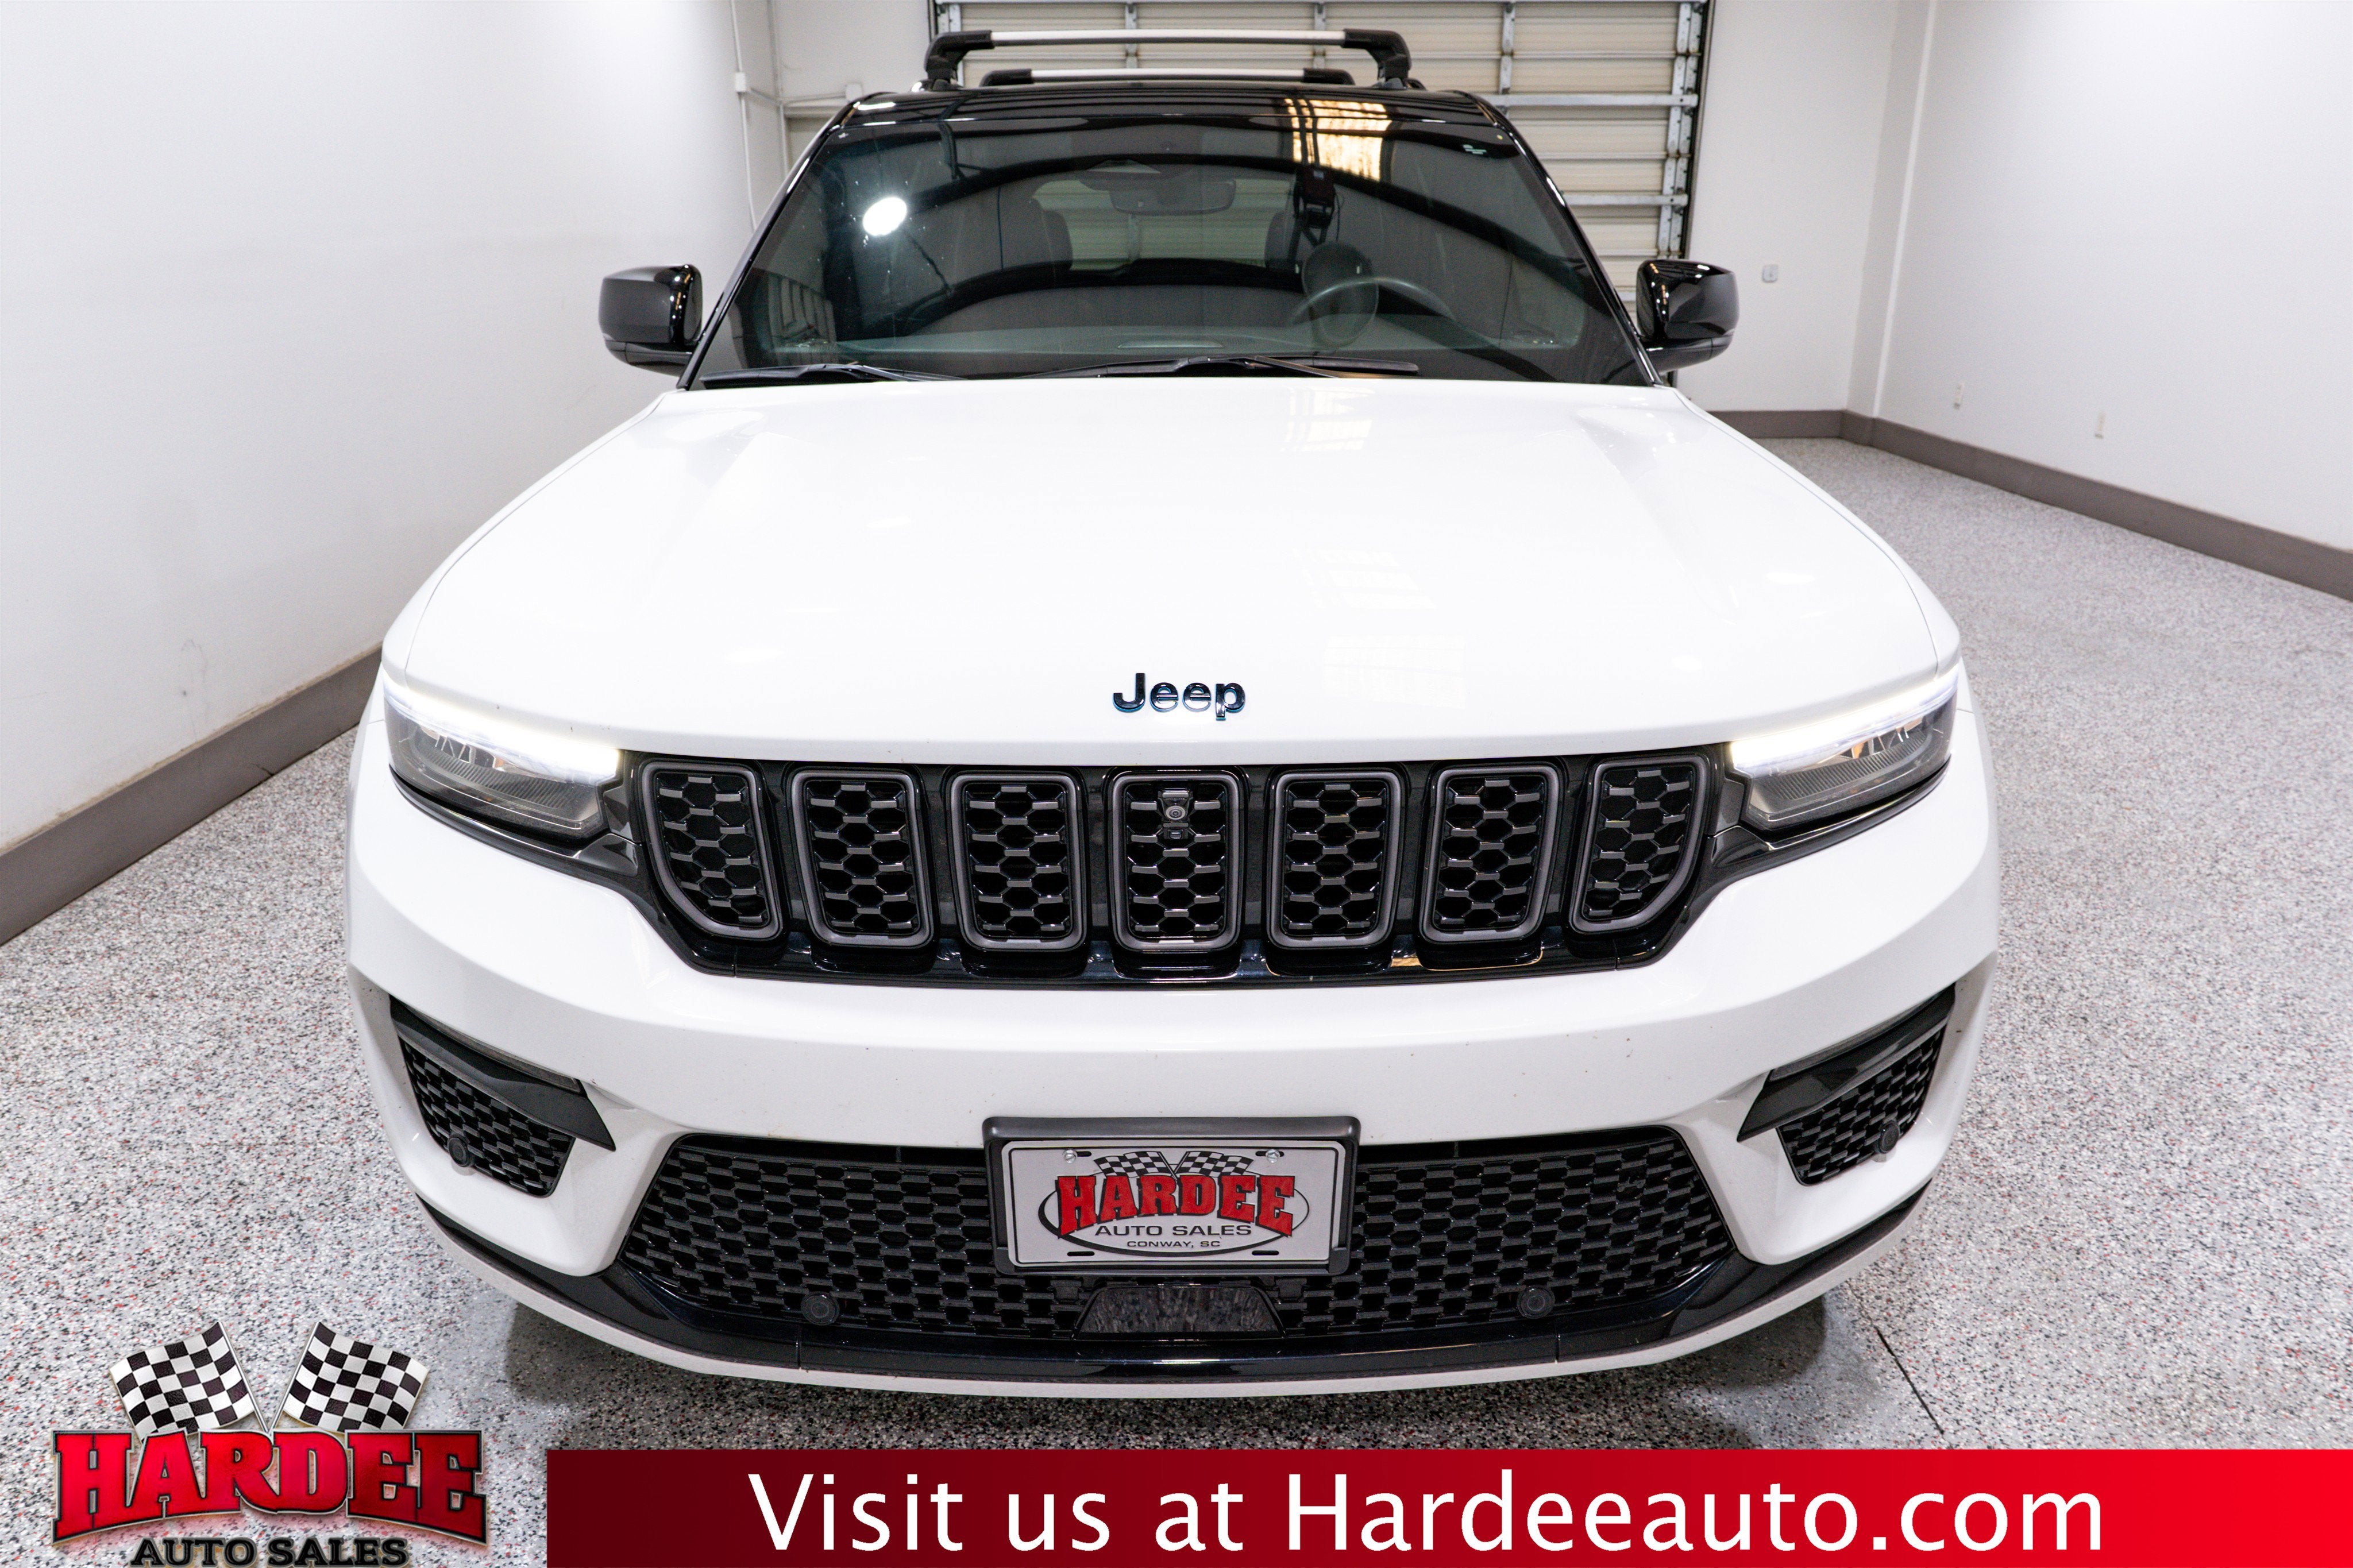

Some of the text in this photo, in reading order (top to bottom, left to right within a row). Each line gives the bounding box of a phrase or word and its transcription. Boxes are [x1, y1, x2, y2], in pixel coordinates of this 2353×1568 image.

[1113, 673, 1245, 721] Jeep
[1055, 1175, 1295, 1239] HARDEE
[1095, 1225, 1252, 1236] AUTO SALES
